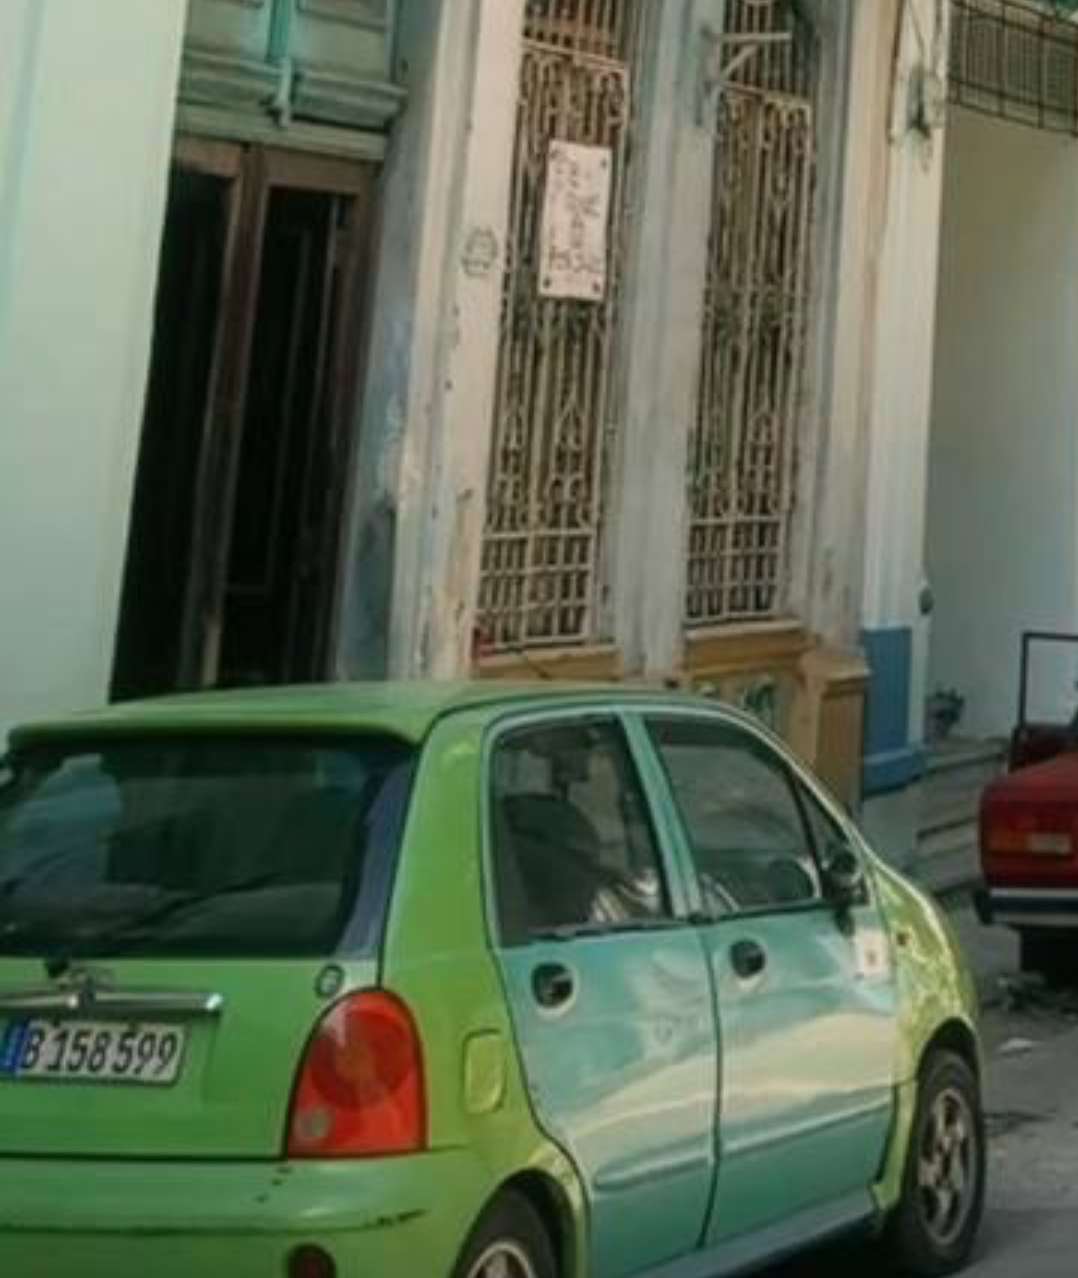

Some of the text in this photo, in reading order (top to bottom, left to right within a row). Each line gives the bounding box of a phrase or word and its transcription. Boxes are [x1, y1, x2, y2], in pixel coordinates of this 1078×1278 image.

[21, 1026, 178, 1076] B 158 599
